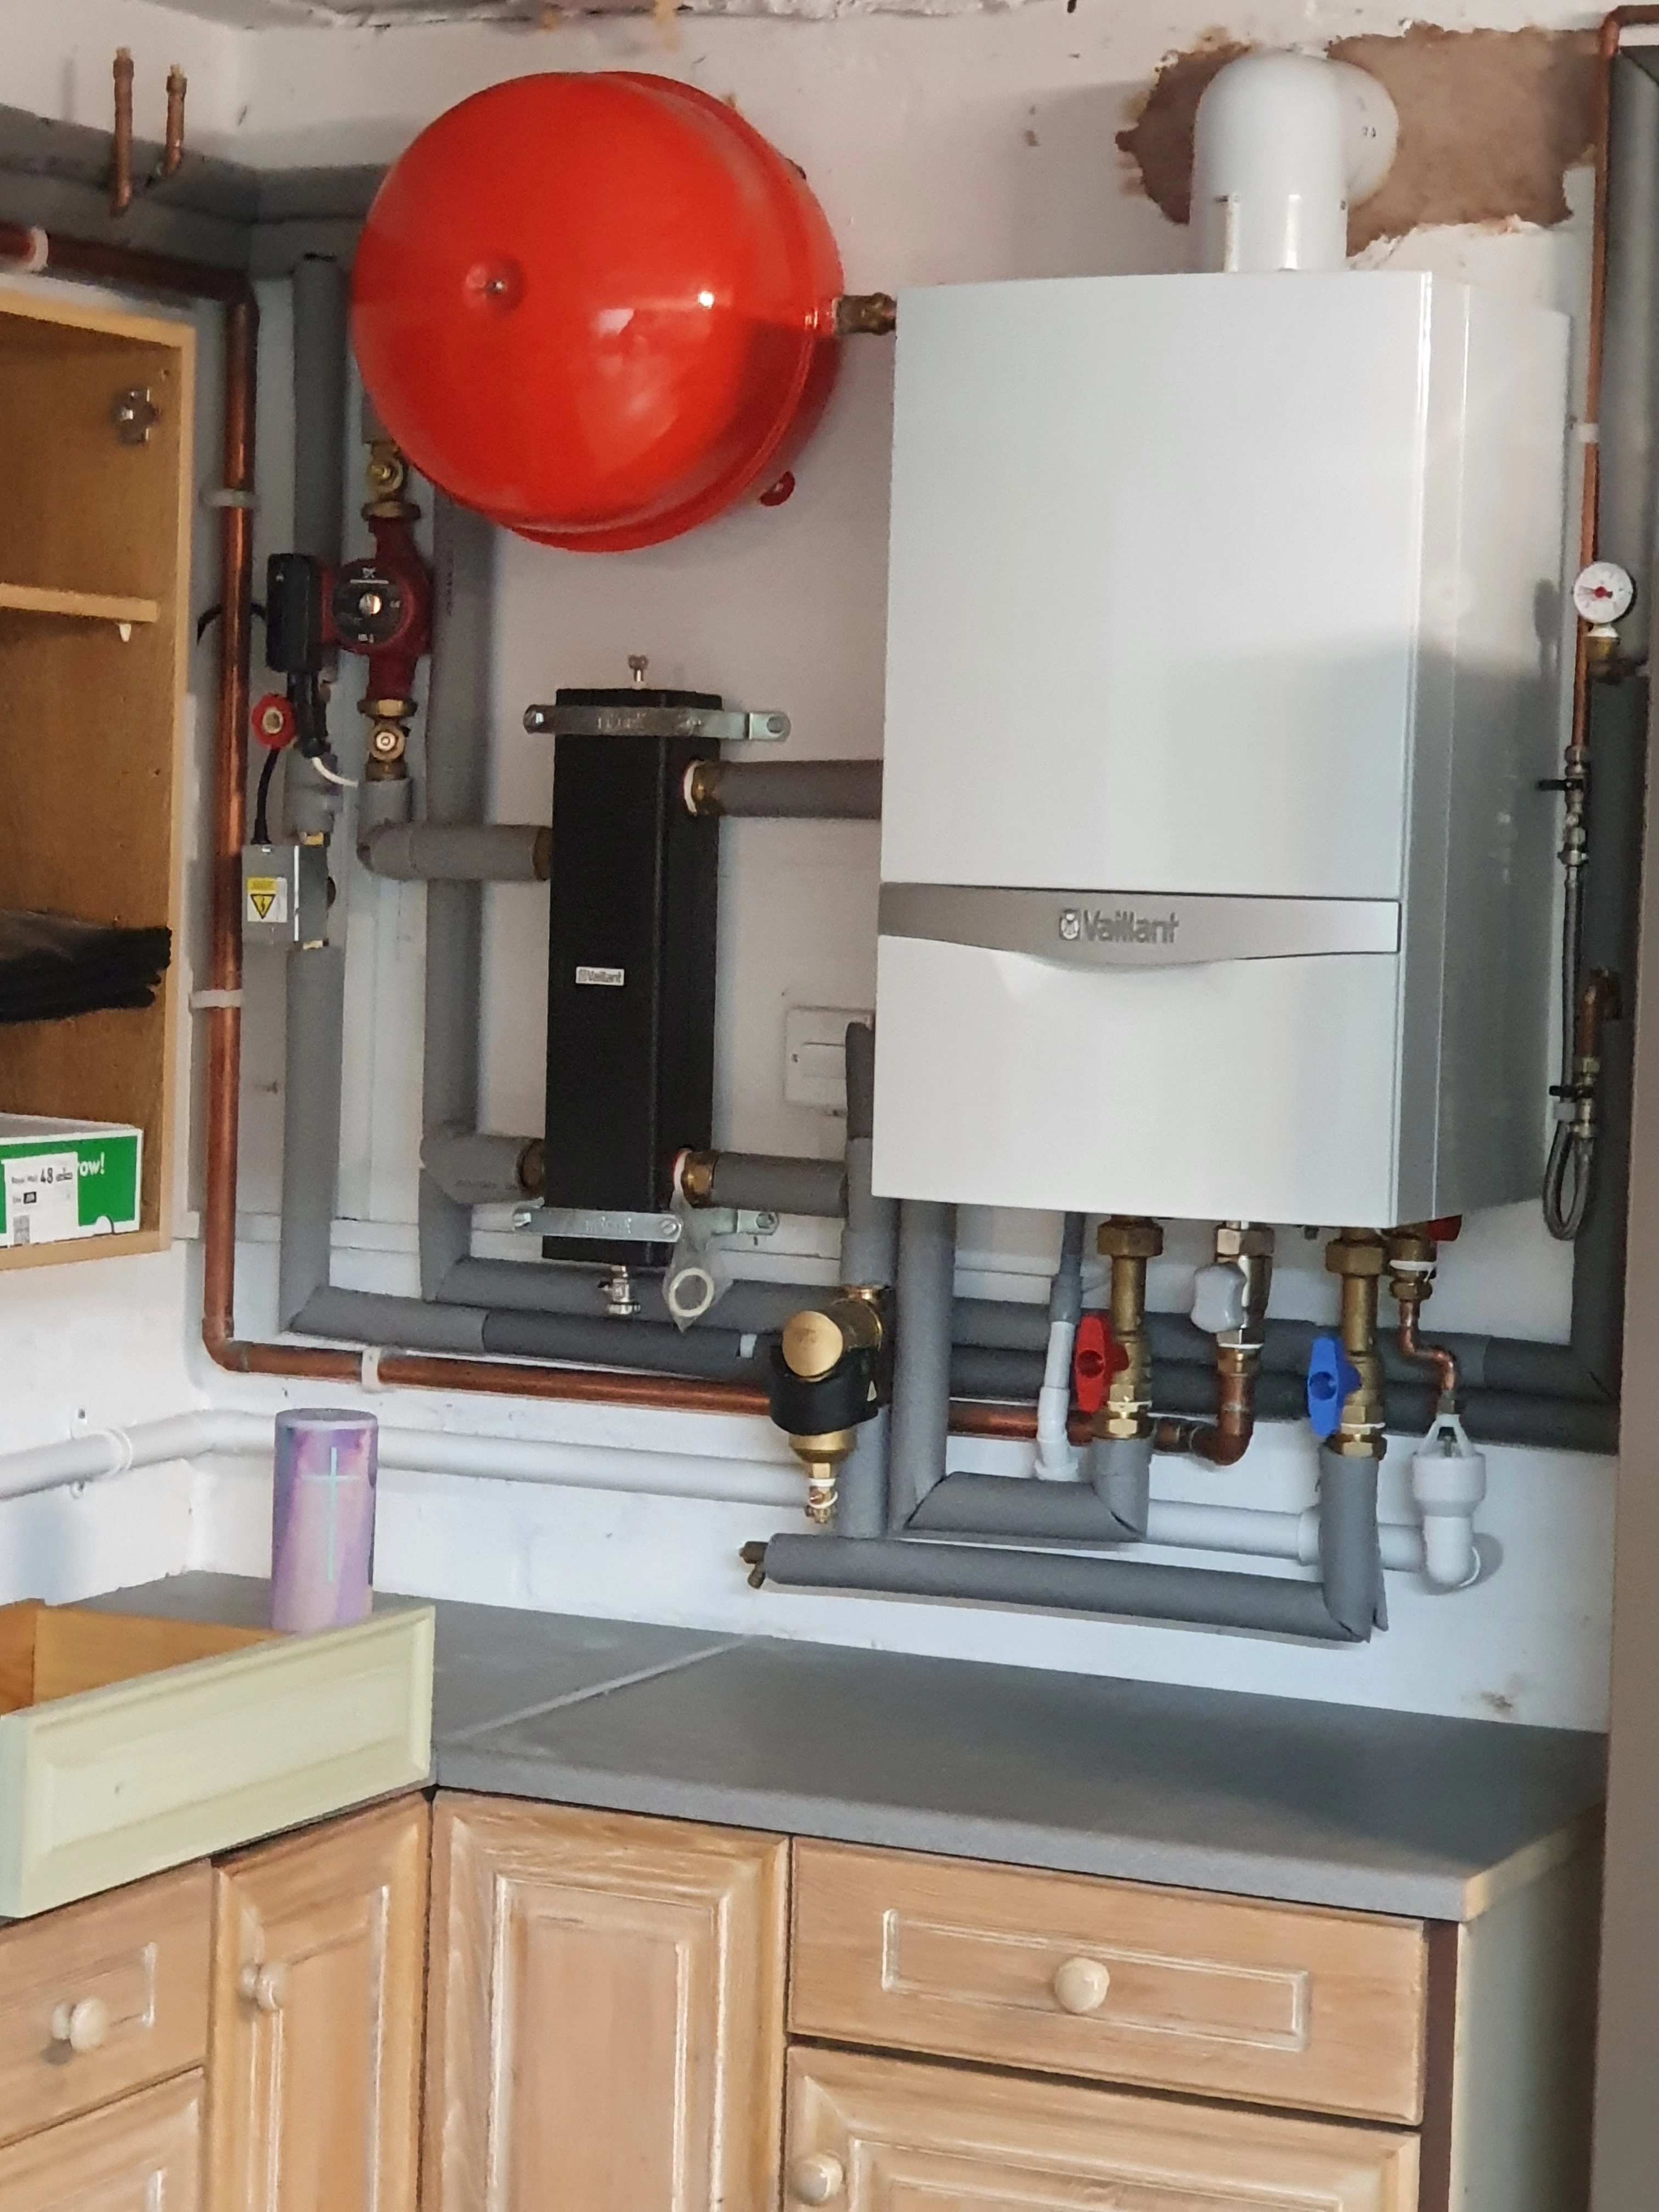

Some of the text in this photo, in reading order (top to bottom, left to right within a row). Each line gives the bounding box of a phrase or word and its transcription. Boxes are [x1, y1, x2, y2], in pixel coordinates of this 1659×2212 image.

[1084, 909, 1179, 944] Vaillant
[41, 1167, 53, 1183] 48
[78, 1152, 105, 1176] ow!
